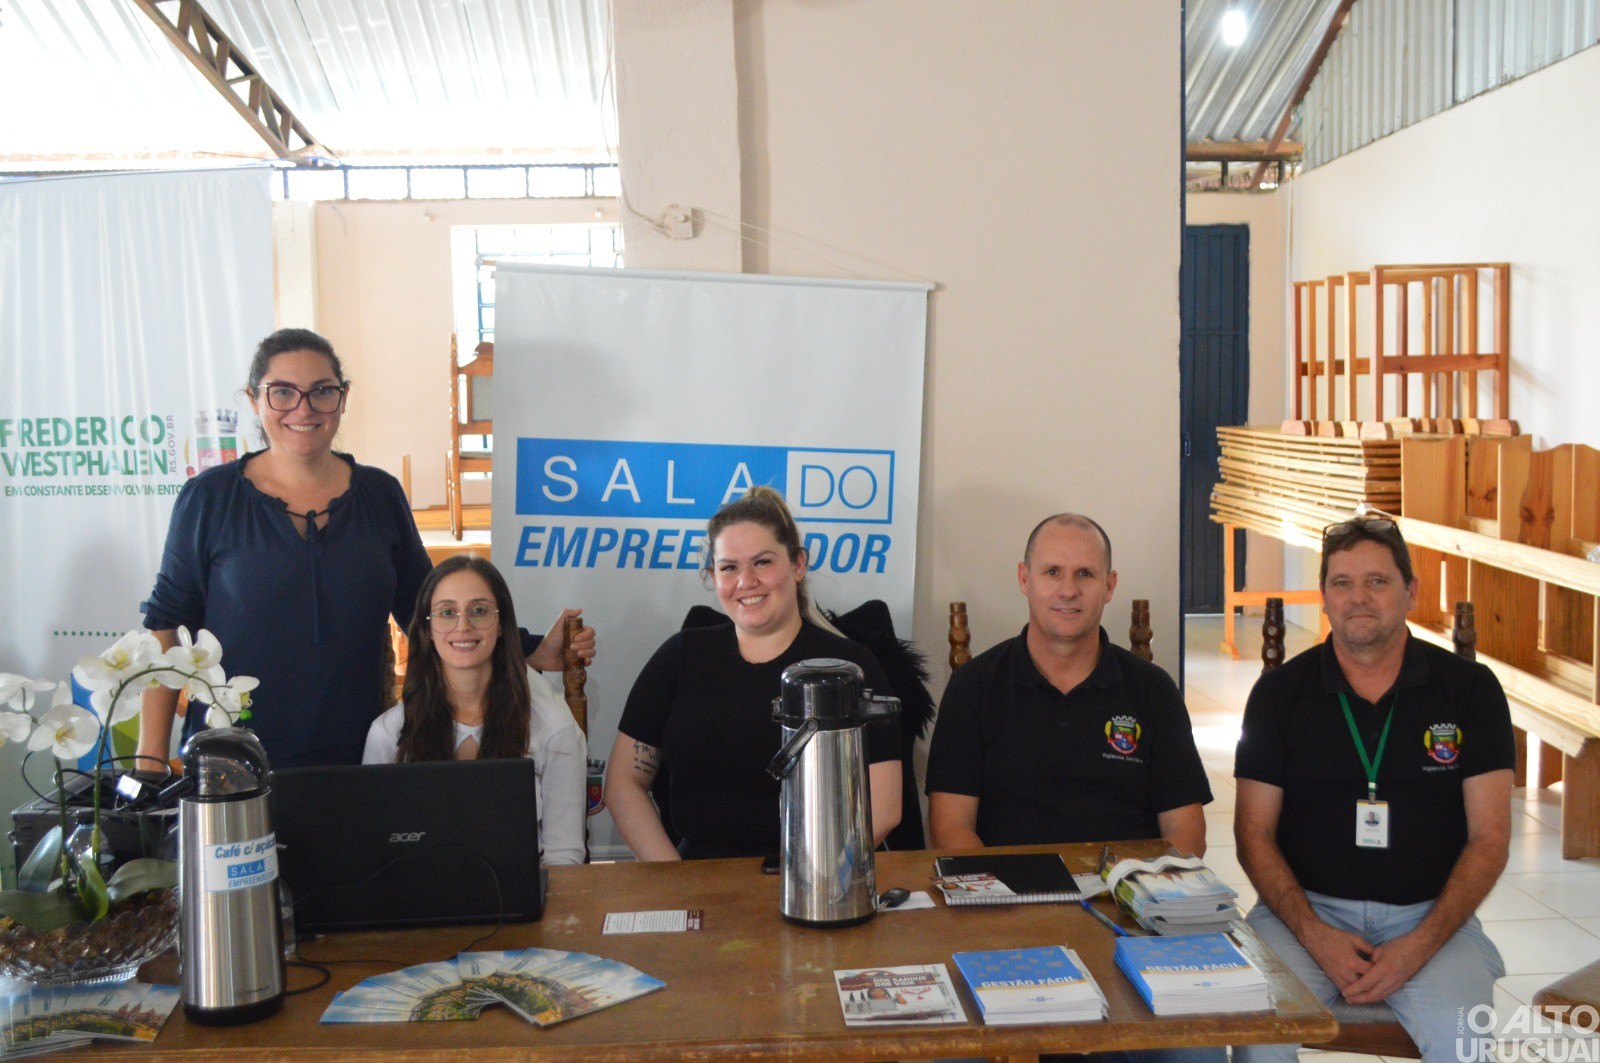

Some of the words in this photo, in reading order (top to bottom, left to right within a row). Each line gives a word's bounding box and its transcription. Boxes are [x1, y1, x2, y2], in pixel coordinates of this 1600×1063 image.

[0, 414, 166, 448] FREDERICO
[0, 449, 169, 477] WESTPHALEN
[541, 455, 754, 505] SALA
[800, 464, 878, 510] DO
[24, 485, 84, 497] CONSTANTE
[514, 525, 892, 574] EMPREEDOR
[389, 832, 426, 843] acer
[215, 843, 242, 859] Café
[244, 841, 255, 855] c/
[231, 862, 264, 877] SALA
[1145, 963, 1199, 972] GESTÃO
[1202, 962, 1243, 971] FÁCIL
[981, 978, 1035, 988] GESTÃO
[1038, 975, 1078, 985] FÁCIL
